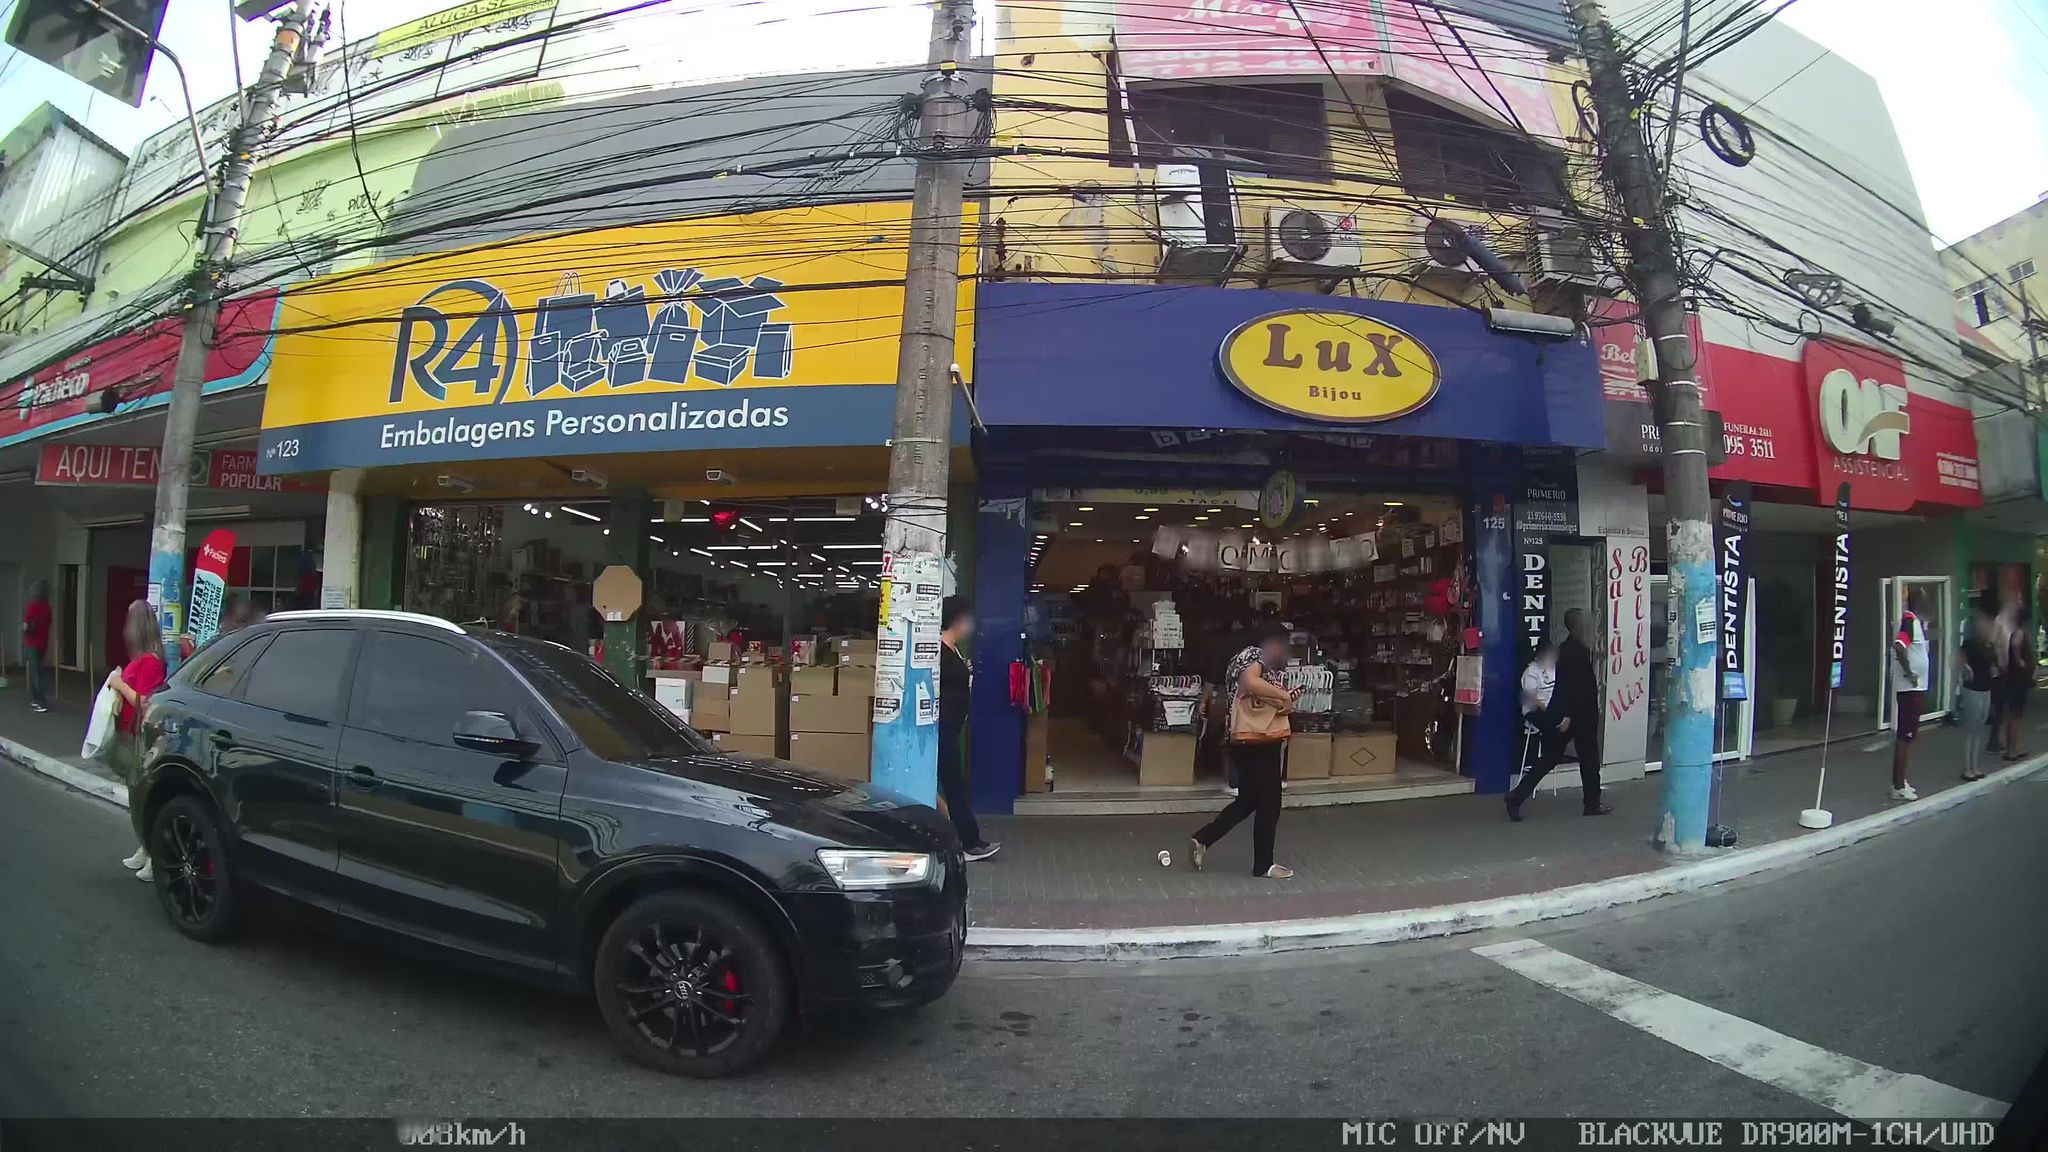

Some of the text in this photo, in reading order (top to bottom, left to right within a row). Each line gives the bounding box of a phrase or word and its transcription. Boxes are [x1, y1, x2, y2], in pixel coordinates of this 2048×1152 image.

[388, 279, 519, 404] R4
[1600, 343, 1636, 364] Bel
[1308, 385, 1362, 401] Bijou
[380, 398, 789, 449] Embalagens Personalizadas
[1724, 422, 1758, 436] FUNERAL
[1750, 437, 1776, 459] 3511
[55, 445, 110, 482] AQUI
[221, 454, 256, 471] FARM
[1833, 457, 1909, 482] ASSISTENCIAL
[220, 472, 283, 492] POPULAR
[1527, 488, 1566, 501] PRIMERIO
[1483, 517, 1505, 530] 125
[1523, 553, 1546, 651] DENTI
[1629, 545, 1648, 669] Bella
[1724, 534, 1742, 670] DENTISTA
[1832, 533, 1849, 660] DENTISTA
[1609, 677, 1645, 722] Mix
